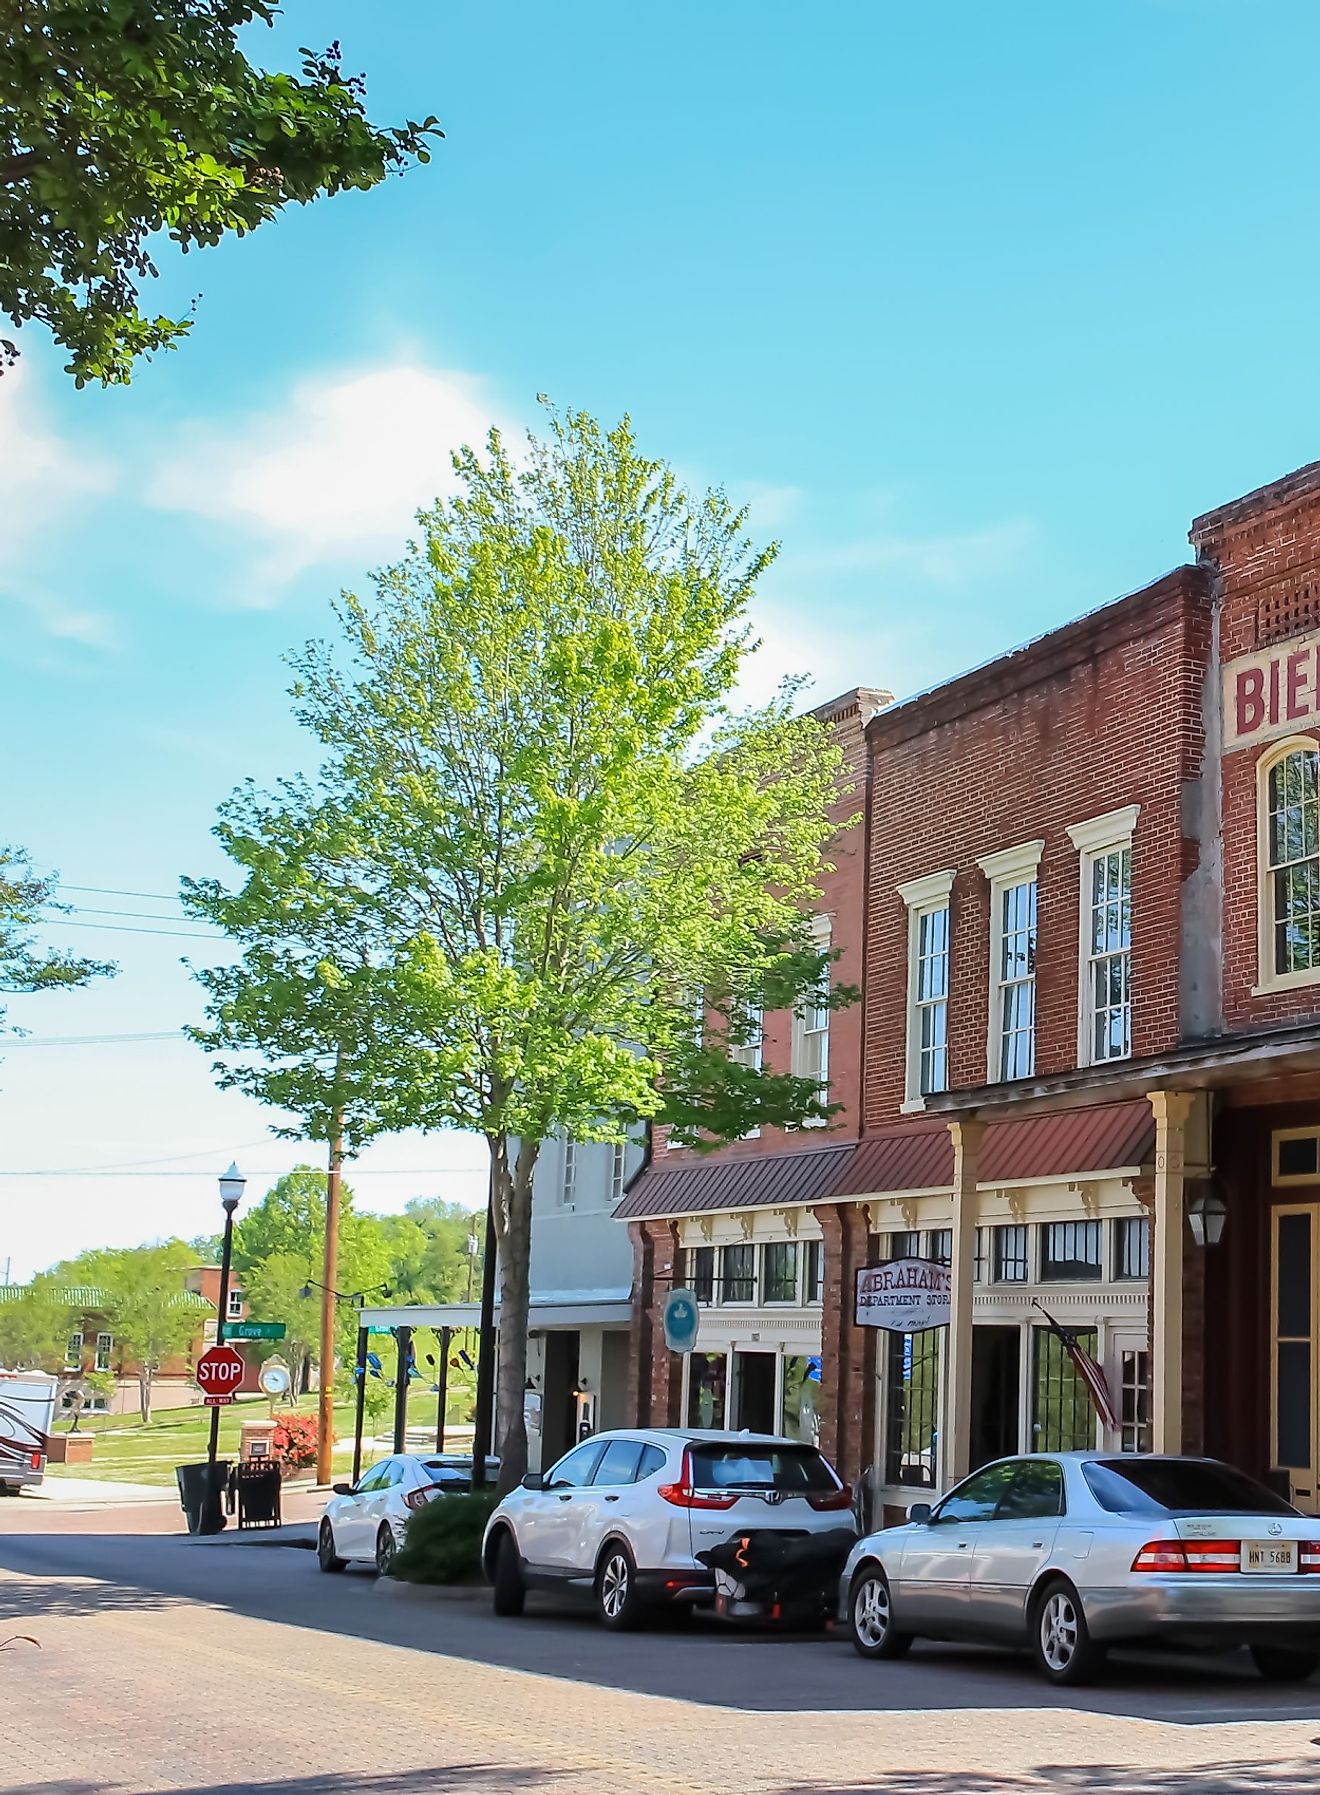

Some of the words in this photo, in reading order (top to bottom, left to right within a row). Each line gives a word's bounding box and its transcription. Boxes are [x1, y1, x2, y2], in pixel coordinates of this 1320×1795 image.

[861, 1267, 951, 1292] ABRAHAM'S
[860, 1295, 921, 1306] DEPARTMENT
[238, 1325, 262, 1336] Grove
[199, 1362, 241, 1380] STOP
[1249, 1551, 1264, 1564] HNT
